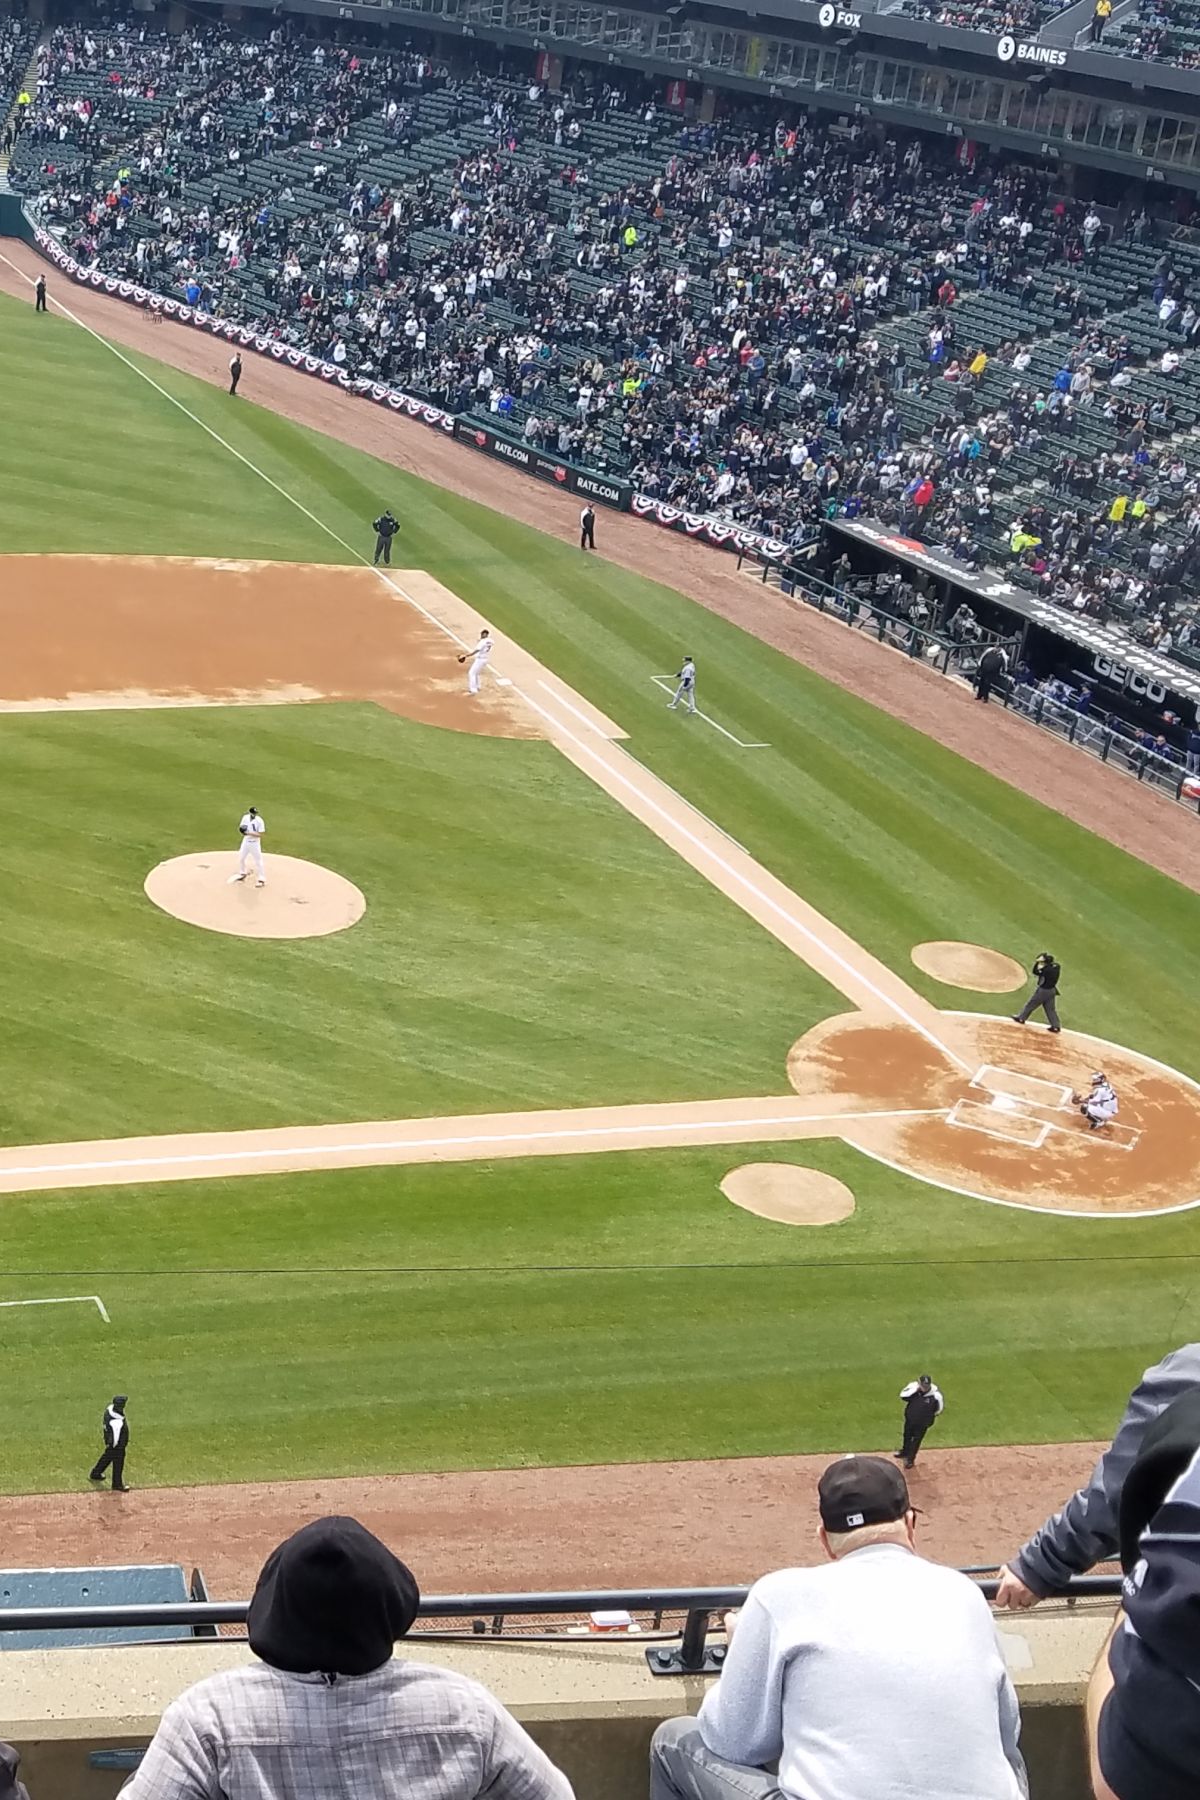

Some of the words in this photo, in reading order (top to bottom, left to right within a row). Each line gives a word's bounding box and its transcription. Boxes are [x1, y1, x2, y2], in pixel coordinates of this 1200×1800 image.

[823, 10, 830, 21] 2
[837, 11, 862, 27] FOX
[1003, 42, 1010, 54] 3
[1017, 43, 1068, 65] BAINES
[494, 440, 529, 464] RATE.COM
[577, 476, 619, 501] RATE.COM
[1094, 654, 1166, 704] GEICO
